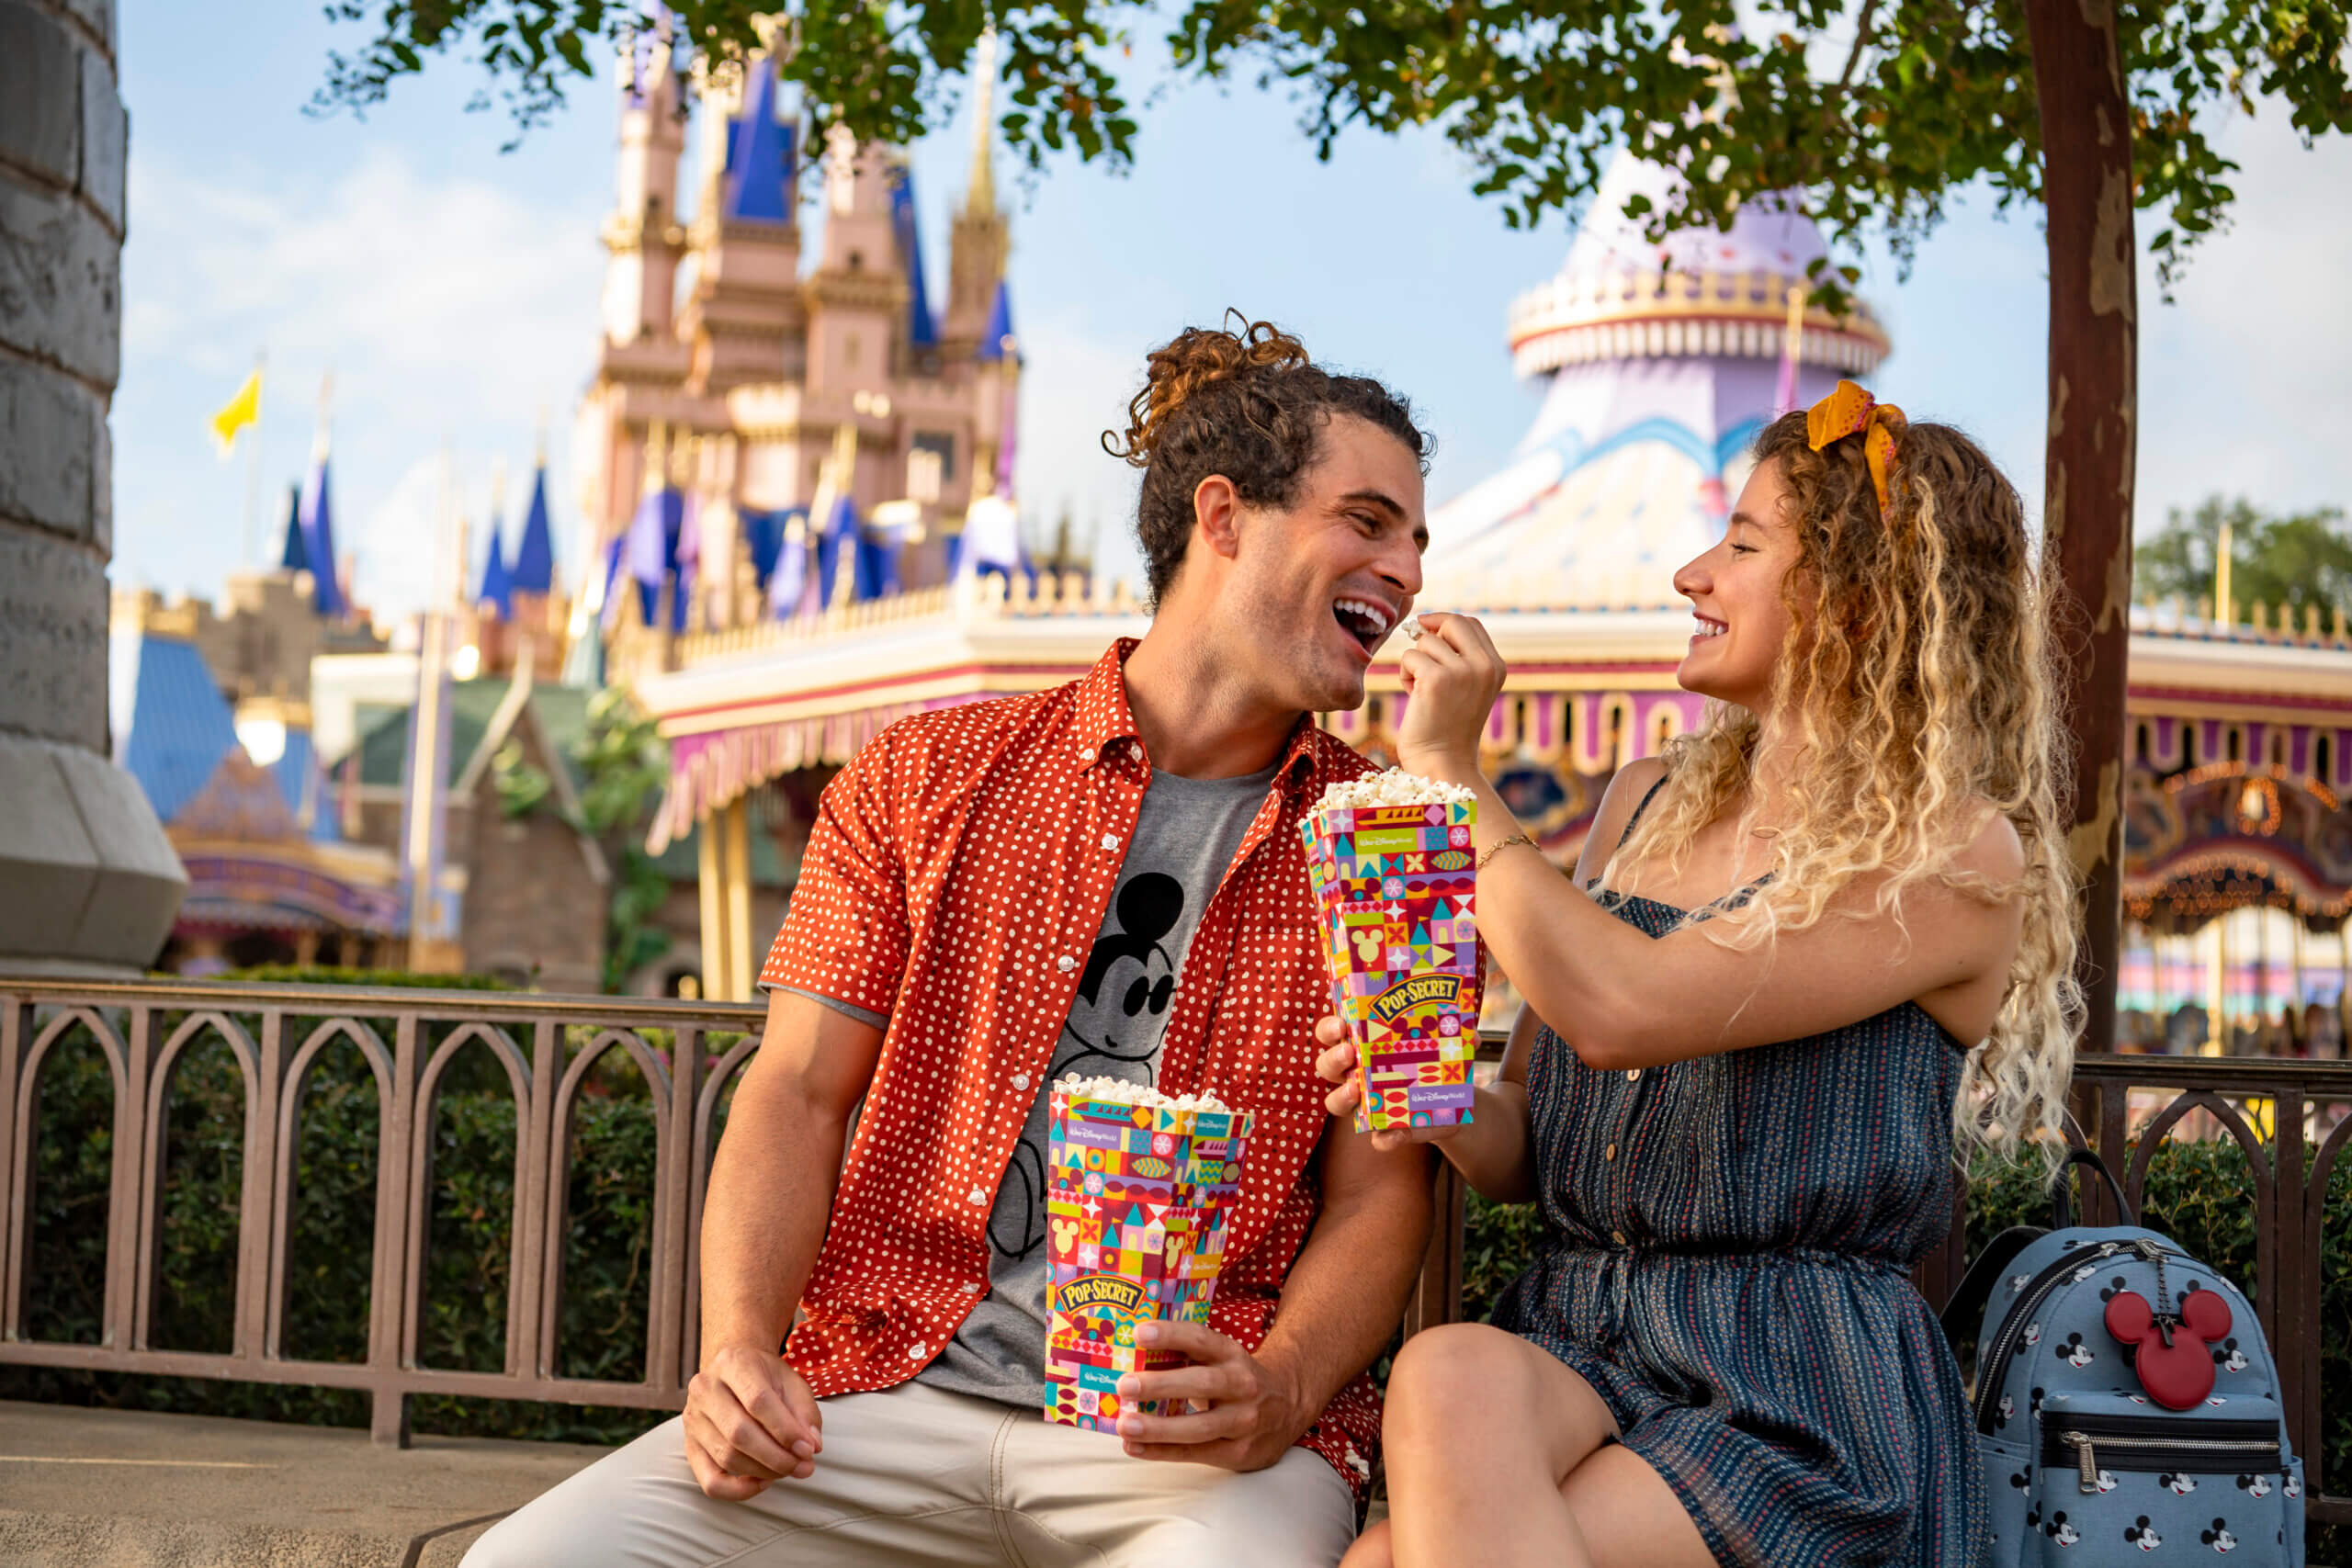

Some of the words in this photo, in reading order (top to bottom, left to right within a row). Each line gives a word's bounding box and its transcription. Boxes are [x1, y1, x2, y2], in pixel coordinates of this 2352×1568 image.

[1373, 836, 1397, 846] Disney
[1425, 1091, 1449, 1101] Disney
[1080, 1127, 1102, 1142] Disney
